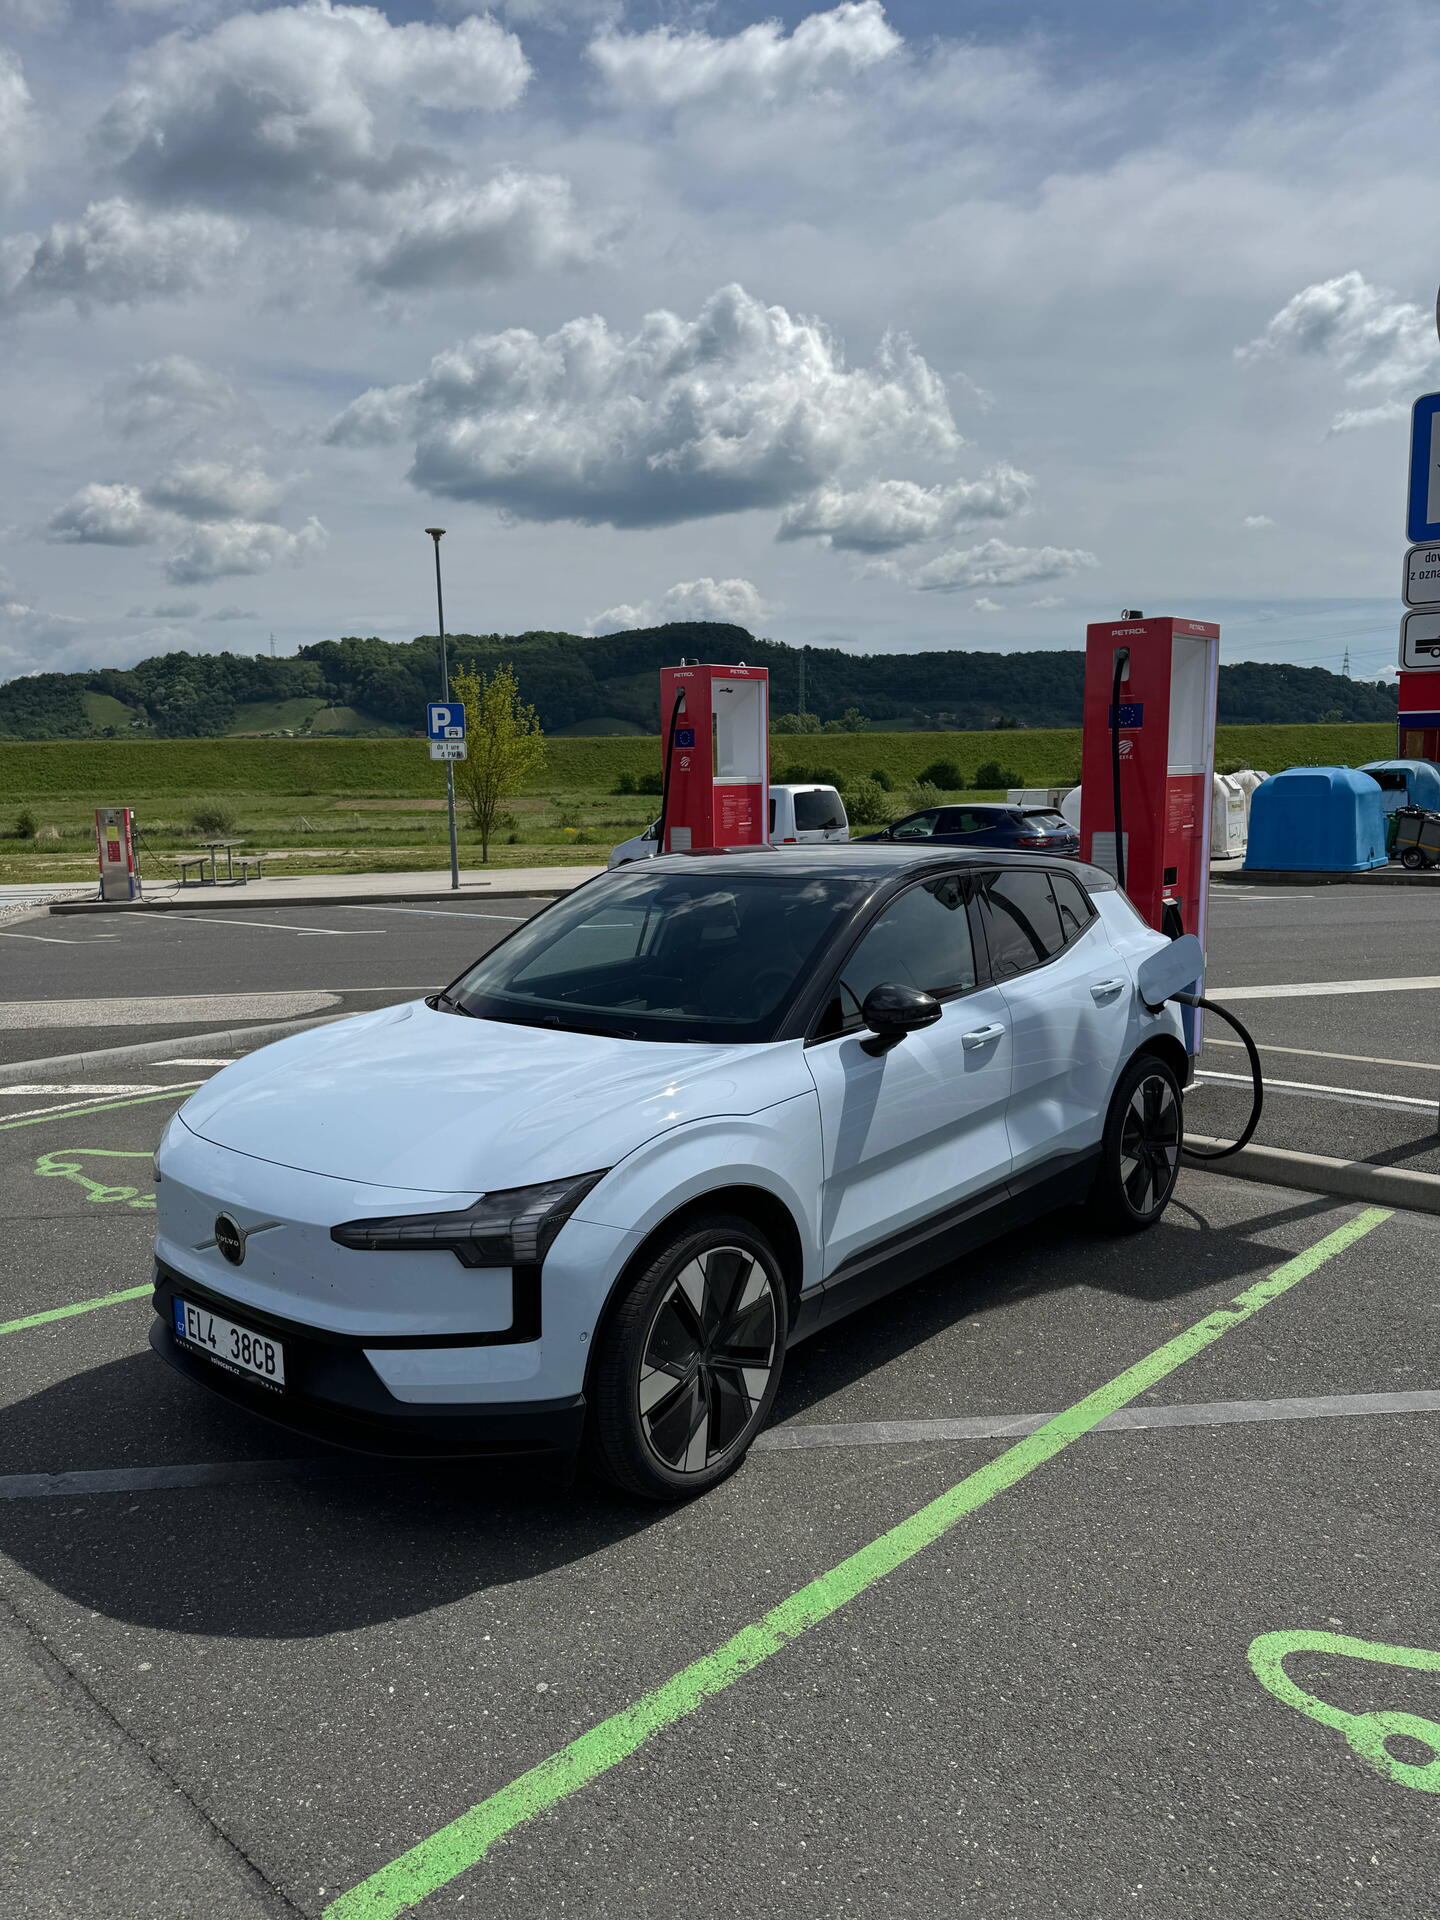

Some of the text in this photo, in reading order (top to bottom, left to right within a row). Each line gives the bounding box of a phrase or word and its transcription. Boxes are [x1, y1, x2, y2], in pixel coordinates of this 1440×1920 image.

[1410, 571, 1416, 581] z
[1111, 628, 1147, 636] PETROL
[1189, 623, 1205, 631] PETROL
[431, 708, 451, 733] P
[216, 1233, 239, 1247] VOLVO
[177, 1321, 185, 1332] CZ
[187, 1306, 276, 1376] EL4 38CB
